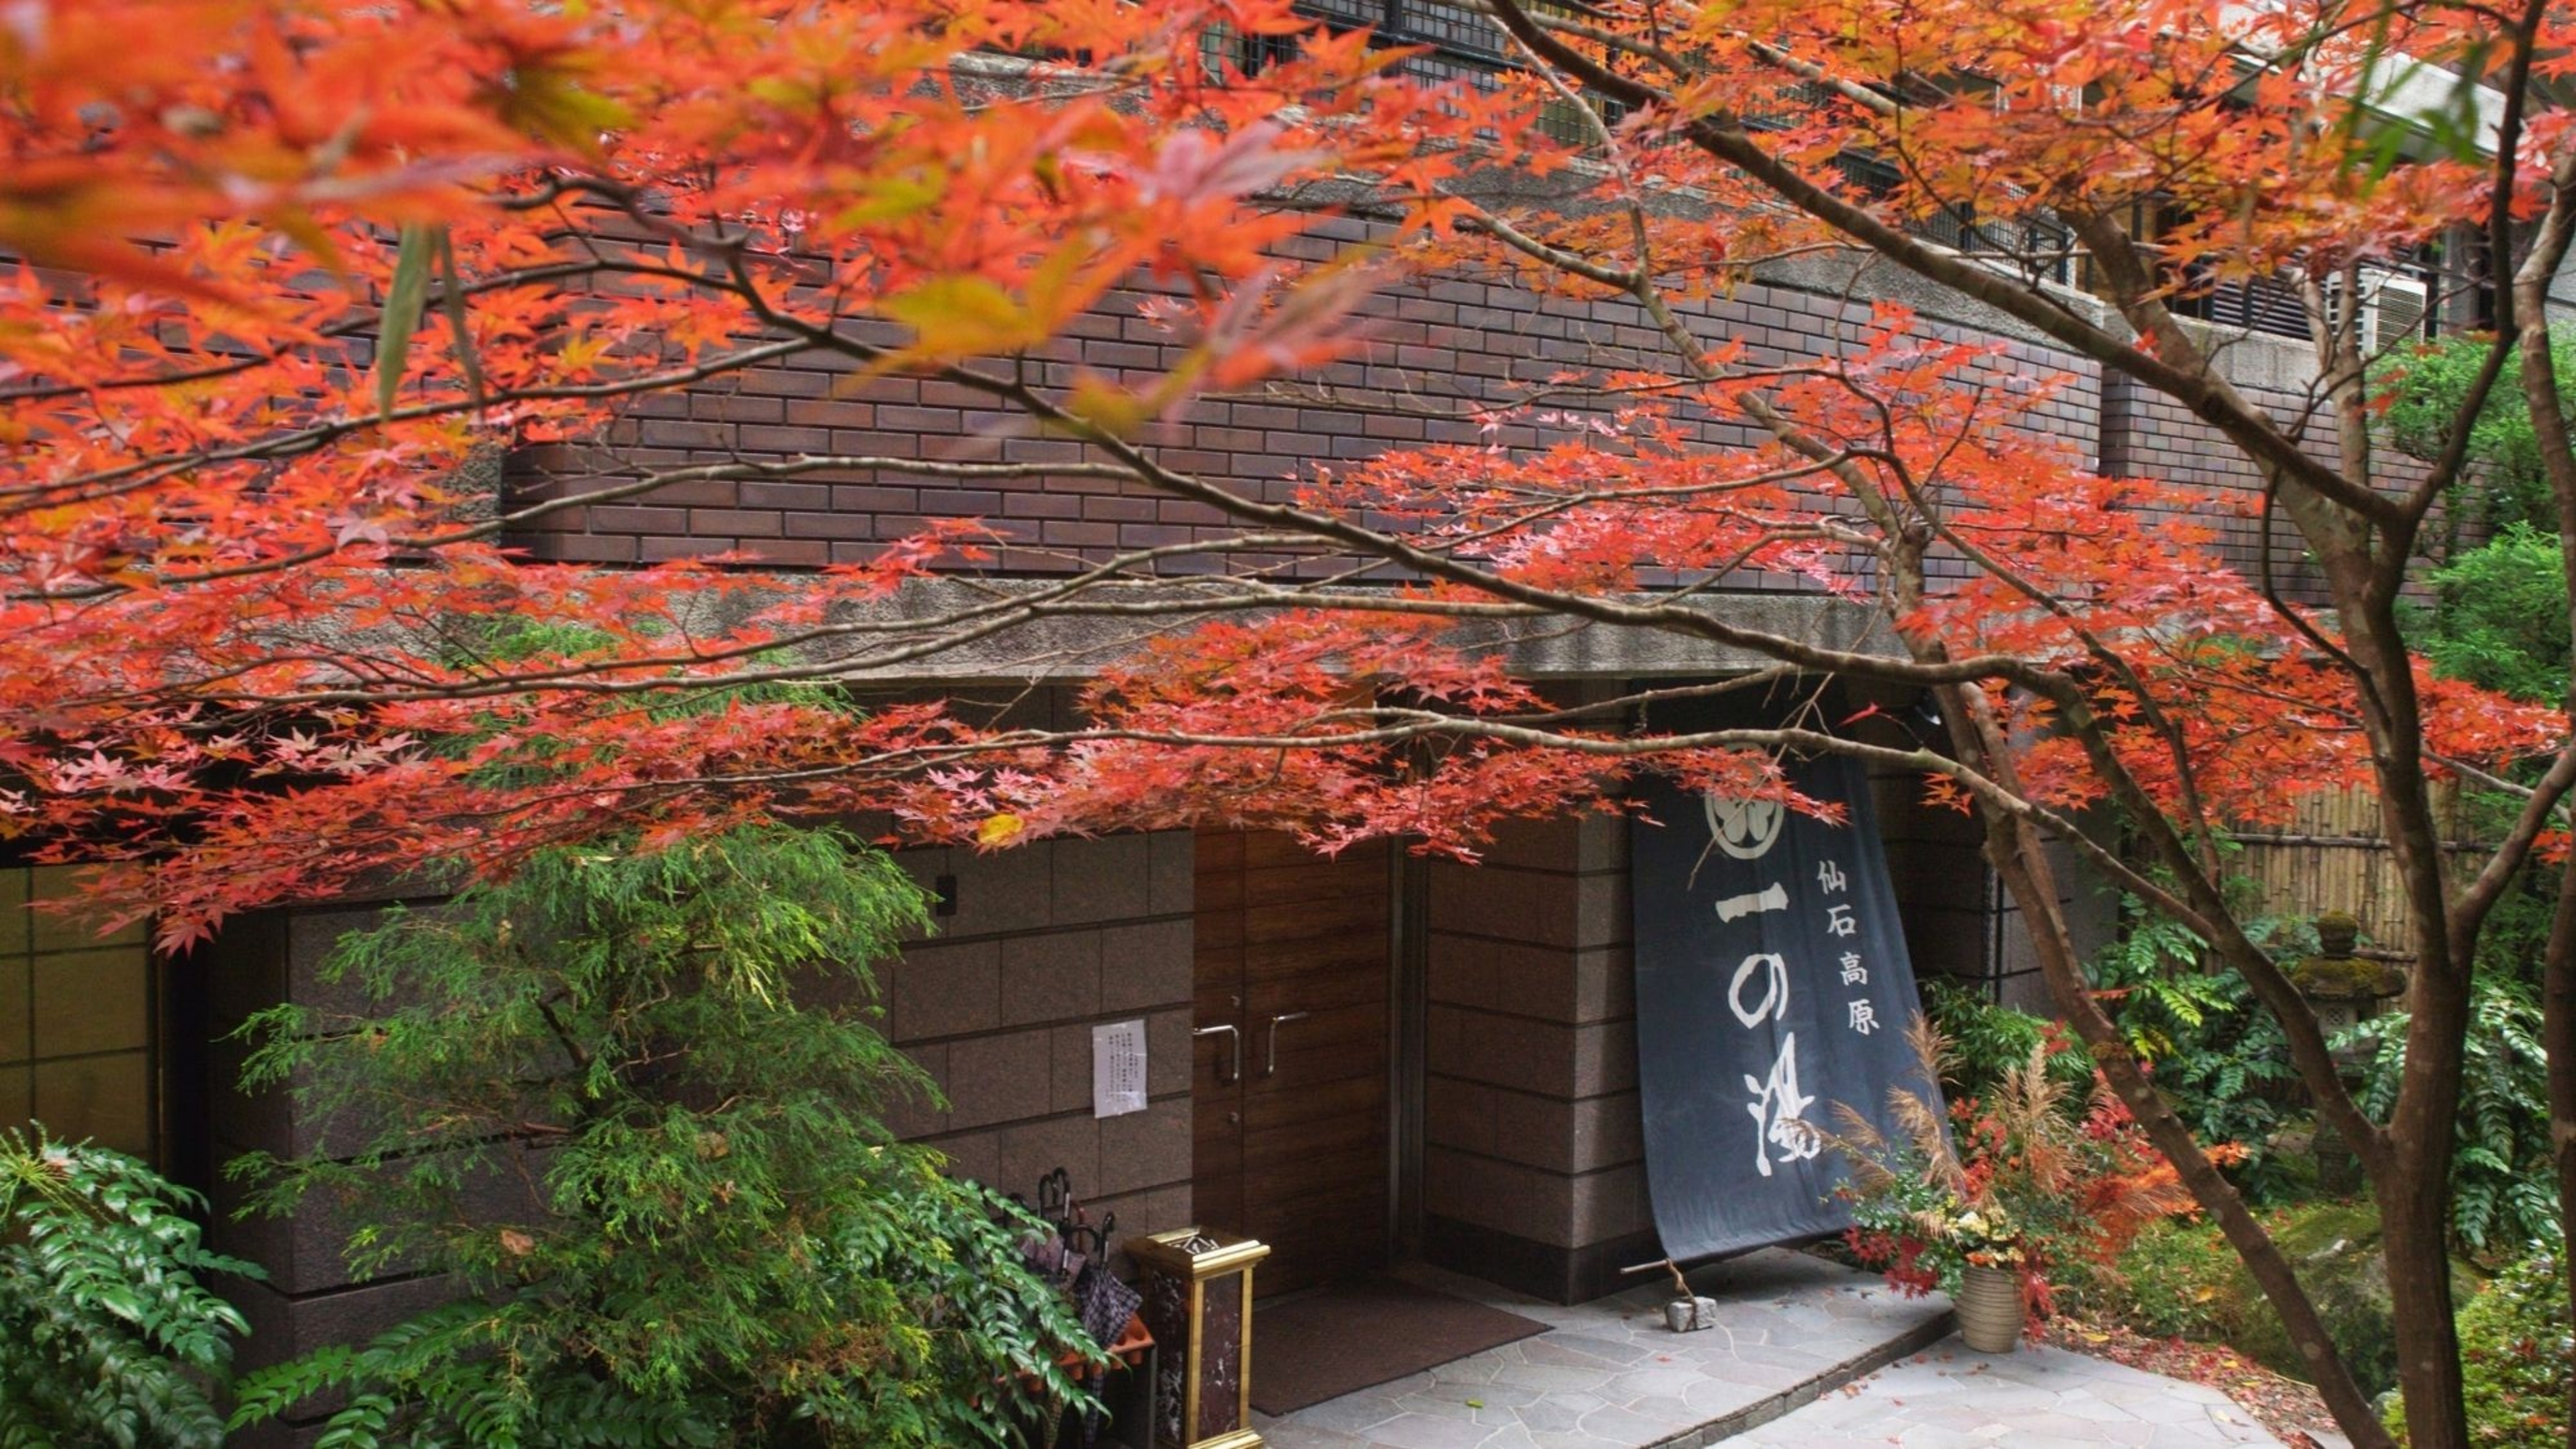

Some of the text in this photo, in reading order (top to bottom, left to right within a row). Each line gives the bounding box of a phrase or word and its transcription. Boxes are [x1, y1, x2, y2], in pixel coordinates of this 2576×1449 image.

[1716, 882, 1822, 1177] 一の湯
[1817, 859, 1881, 1035] 仙石高原
